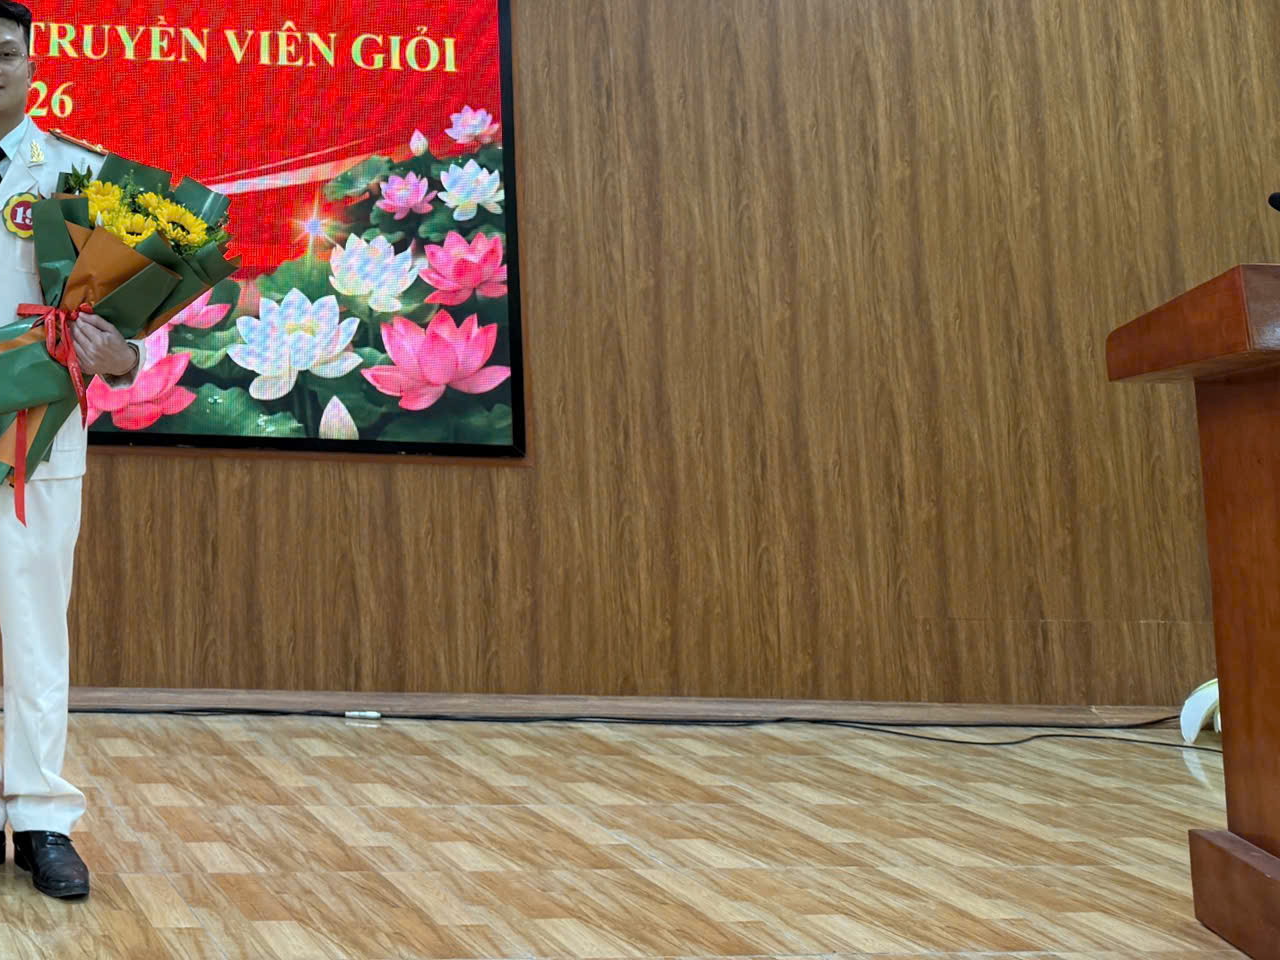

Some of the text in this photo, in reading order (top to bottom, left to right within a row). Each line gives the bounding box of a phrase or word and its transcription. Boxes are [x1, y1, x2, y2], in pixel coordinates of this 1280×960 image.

[224, 21, 336, 67] VIÊN
[351, 26, 457, 72] GIỎI
[27, 80, 73, 118] 26
